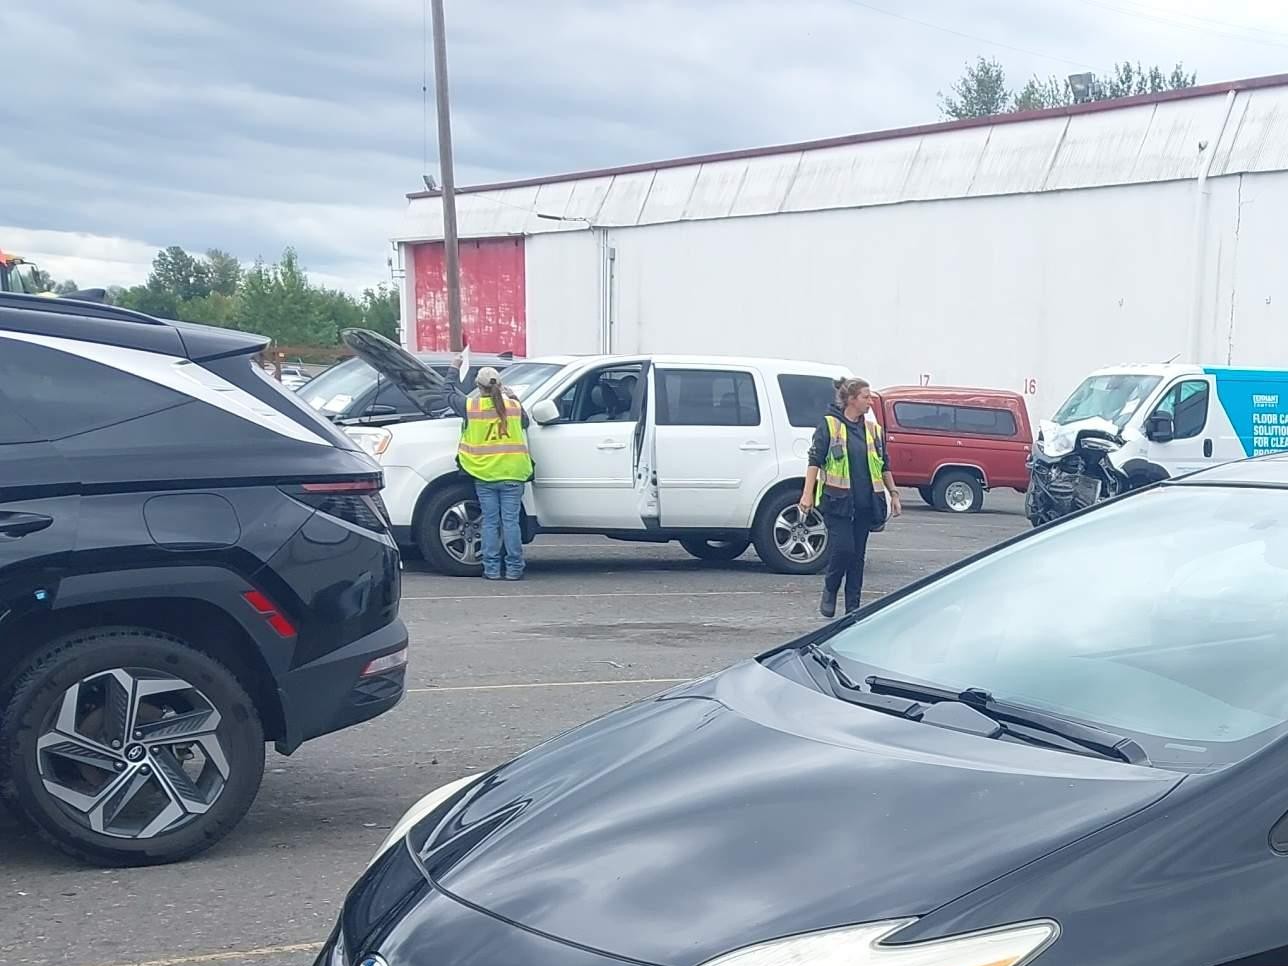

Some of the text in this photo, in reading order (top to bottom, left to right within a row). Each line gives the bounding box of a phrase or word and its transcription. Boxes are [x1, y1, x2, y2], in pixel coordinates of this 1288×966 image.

[919, 374, 930, 389] 17
[1024, 378, 1037, 395] 16
[1253, 413, 1278, 424] FLOOR
[1253, 436, 1269, 447] FOR
